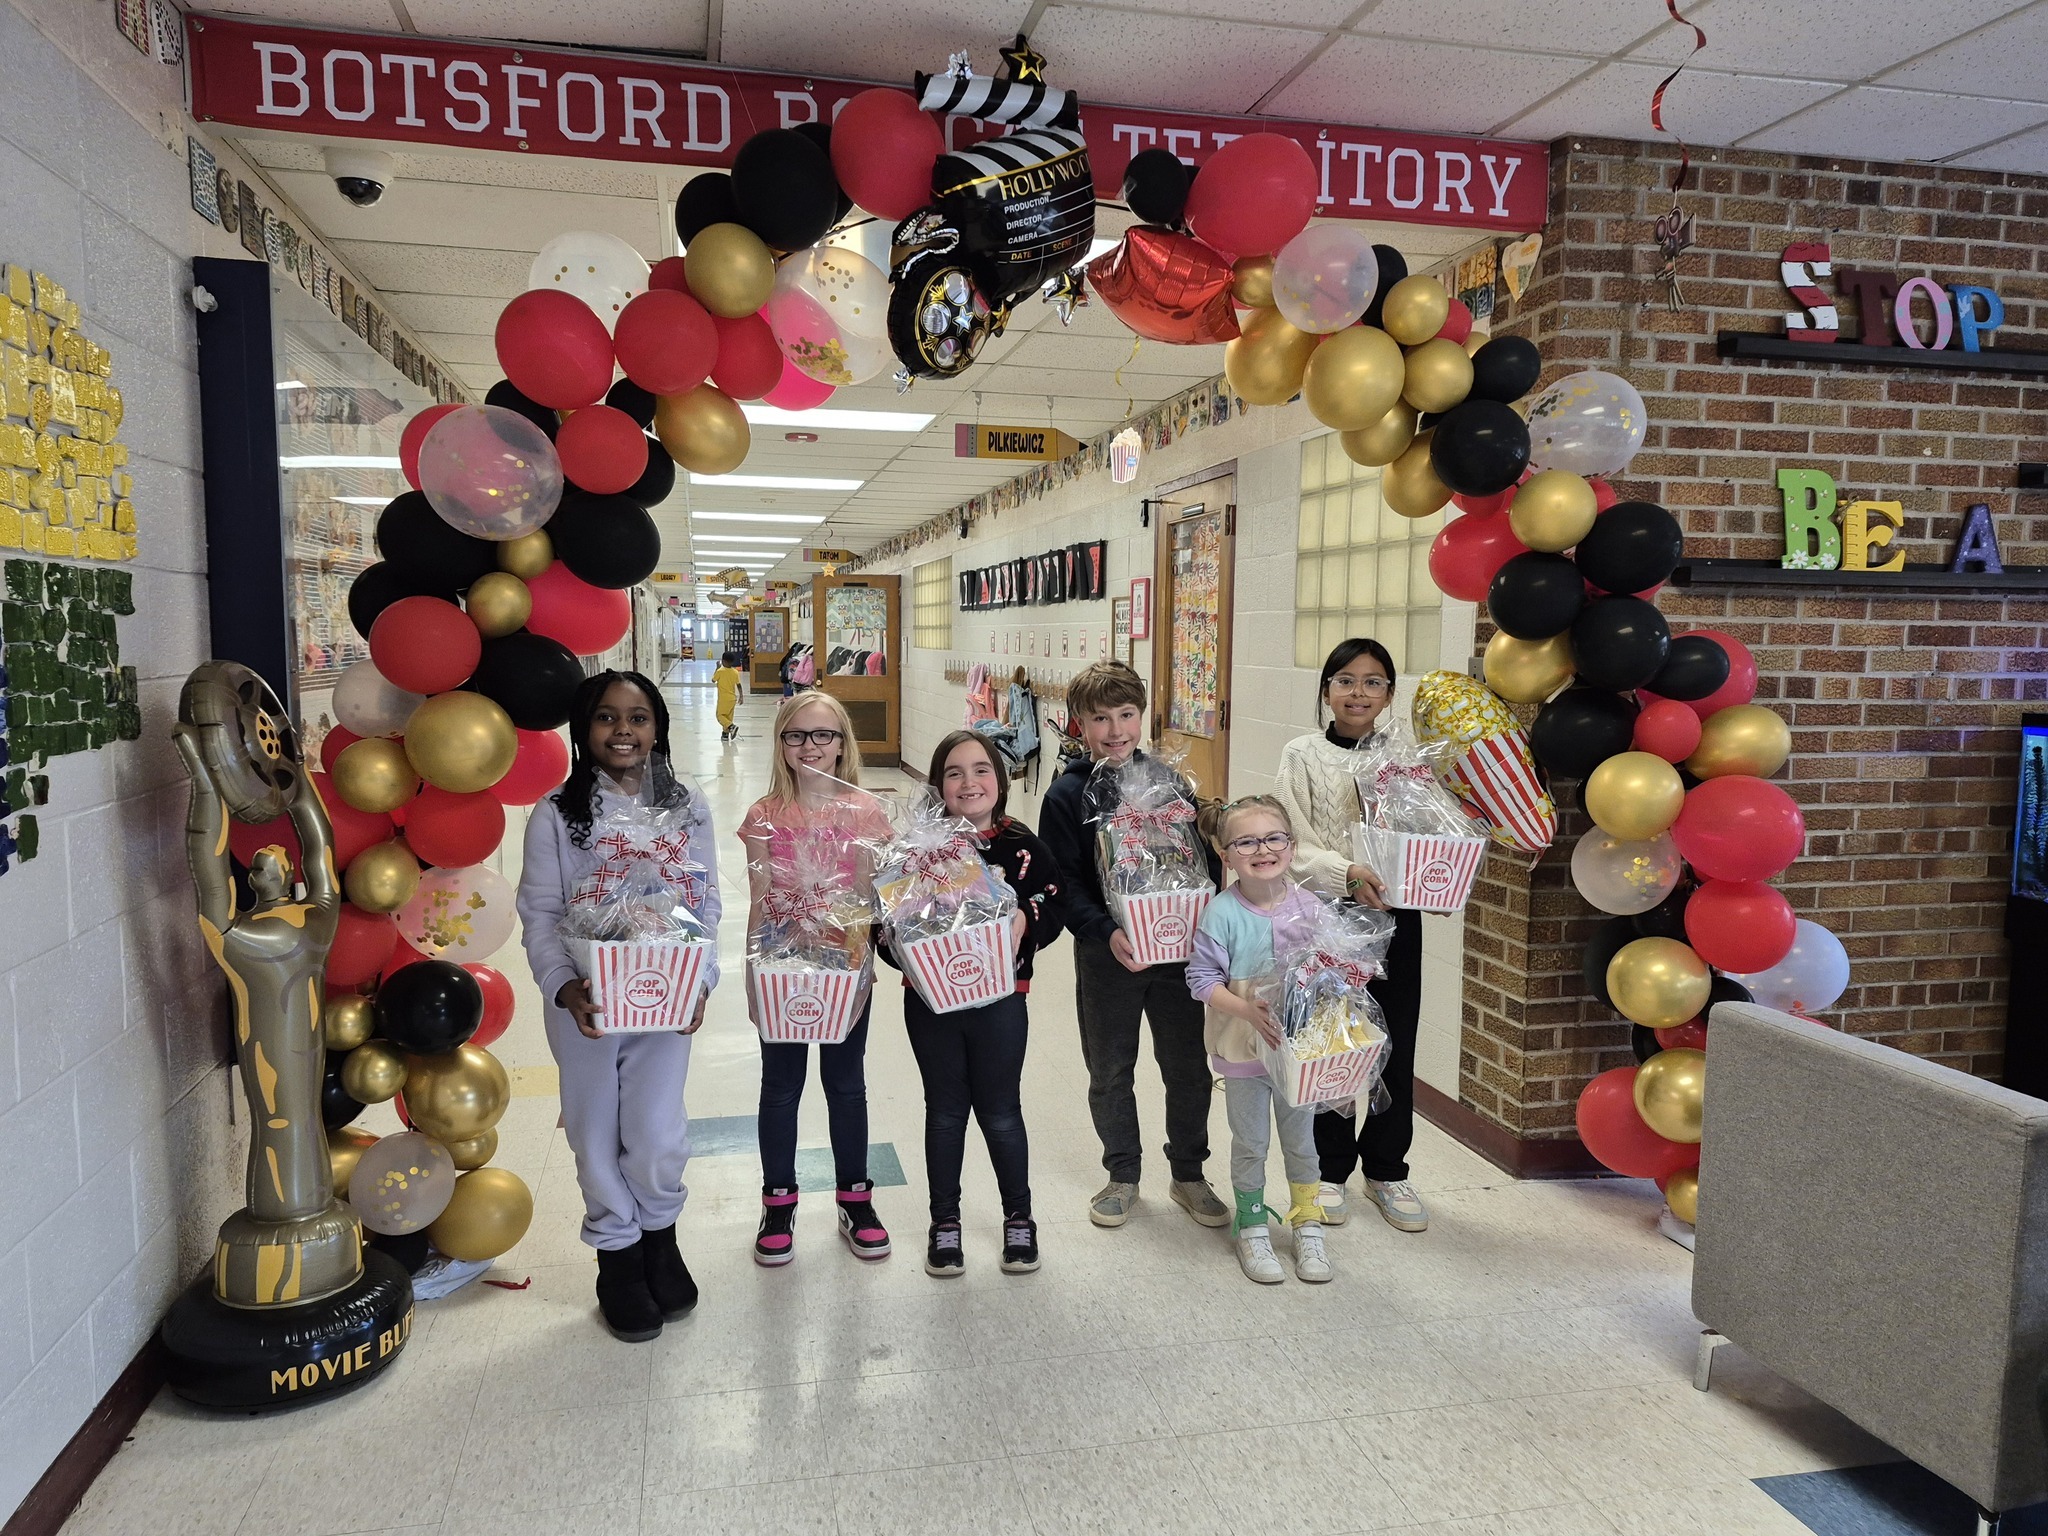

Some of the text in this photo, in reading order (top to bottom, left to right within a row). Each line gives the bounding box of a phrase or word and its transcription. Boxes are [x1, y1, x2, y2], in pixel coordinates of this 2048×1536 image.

[252, 41, 731, 153] BOTSFORD
[1112, 123, 1522, 218] TEITORY
[1004, 195, 1050, 215] PRODUCTION
[1006, 213, 1043, 231] DIRECTOR
[1007, 231, 1038, 245] CAMERA
[1011, 251, 1033, 261] DATE
[1781, 242, 2005, 352] STOP
[988, 431, 1045, 454] PILKIEWICZ
[1776, 468, 2003, 573] BE A
[1428, 868, 1447, 876] POP
[1423, 875, 1449, 884] CORN
[1160, 922, 1179, 930] POP
[1156, 929, 1184, 938] CORN
[953, 959, 974, 971] POP
[950, 966, 981, 980] CORN
[635, 979, 660, 989] POP
[628, 988, 664, 998] CORN
[794, 1001, 815, 1009] POP
[788, 1008, 820, 1017] CORN
[1325, 1071, 1344, 1079] POP
[270, 1341, 372, 1395] MOVIE
